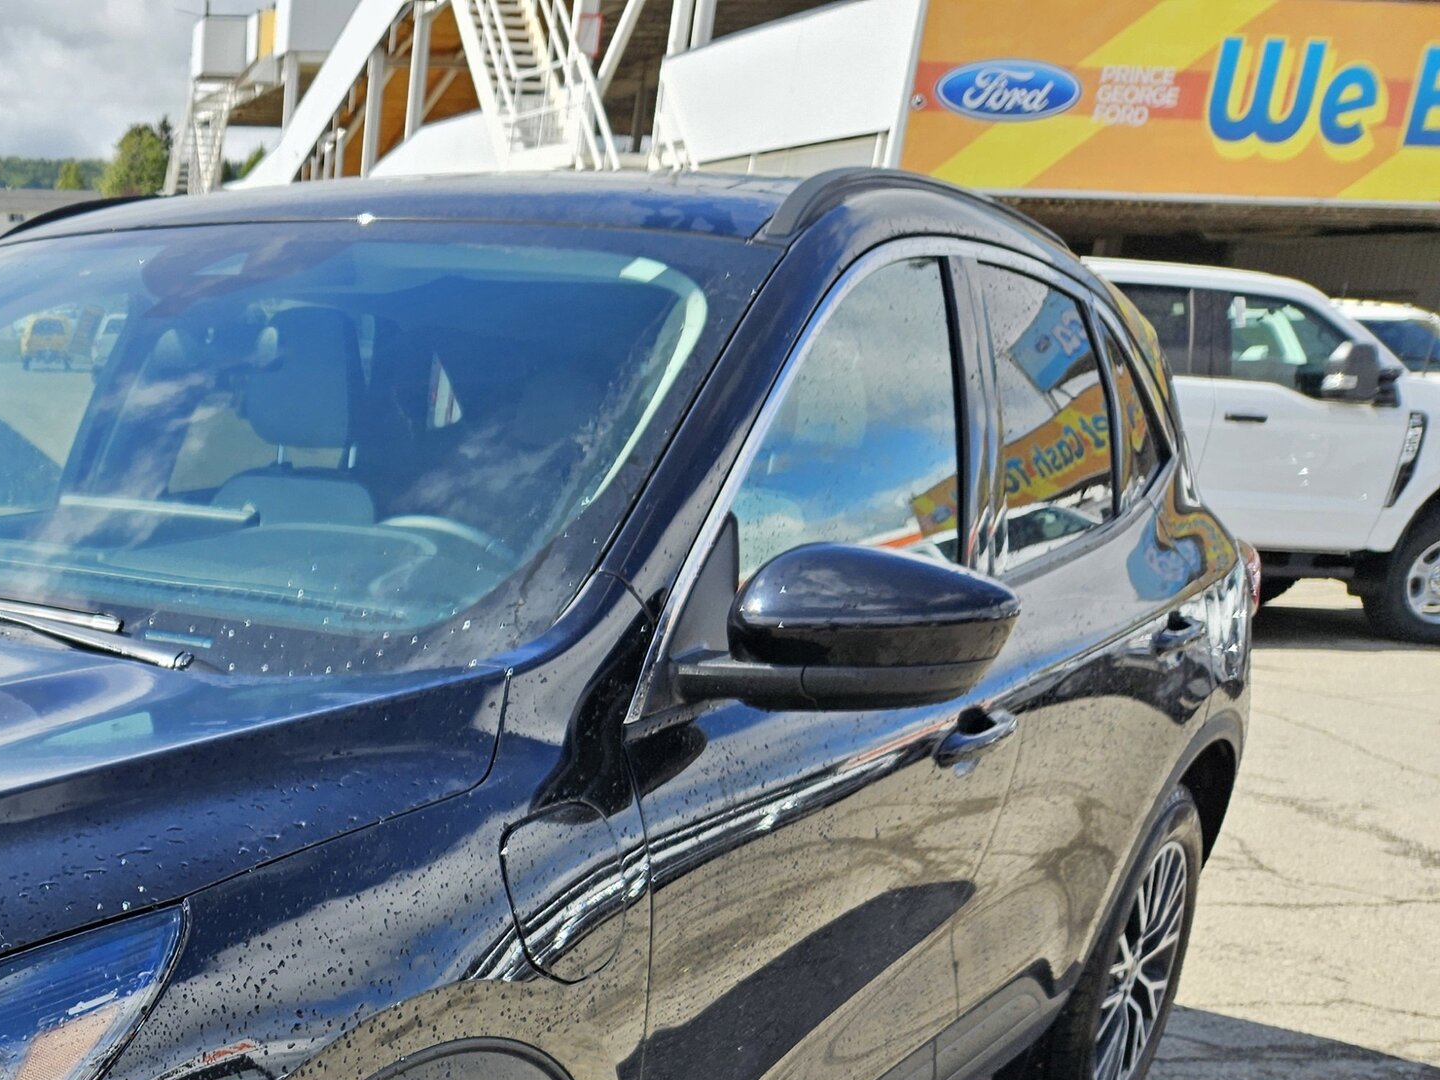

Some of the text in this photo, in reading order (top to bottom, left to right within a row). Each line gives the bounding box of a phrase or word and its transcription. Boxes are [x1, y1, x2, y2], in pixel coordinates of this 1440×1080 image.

[1100, 64, 1177, 85] PRINCE
[962, 66, 1049, 113] Ford
[1096, 84, 1179, 109] GEORGE
[1209, 37, 1377, 145] We
[1091, 103, 1149, 128] FORD
